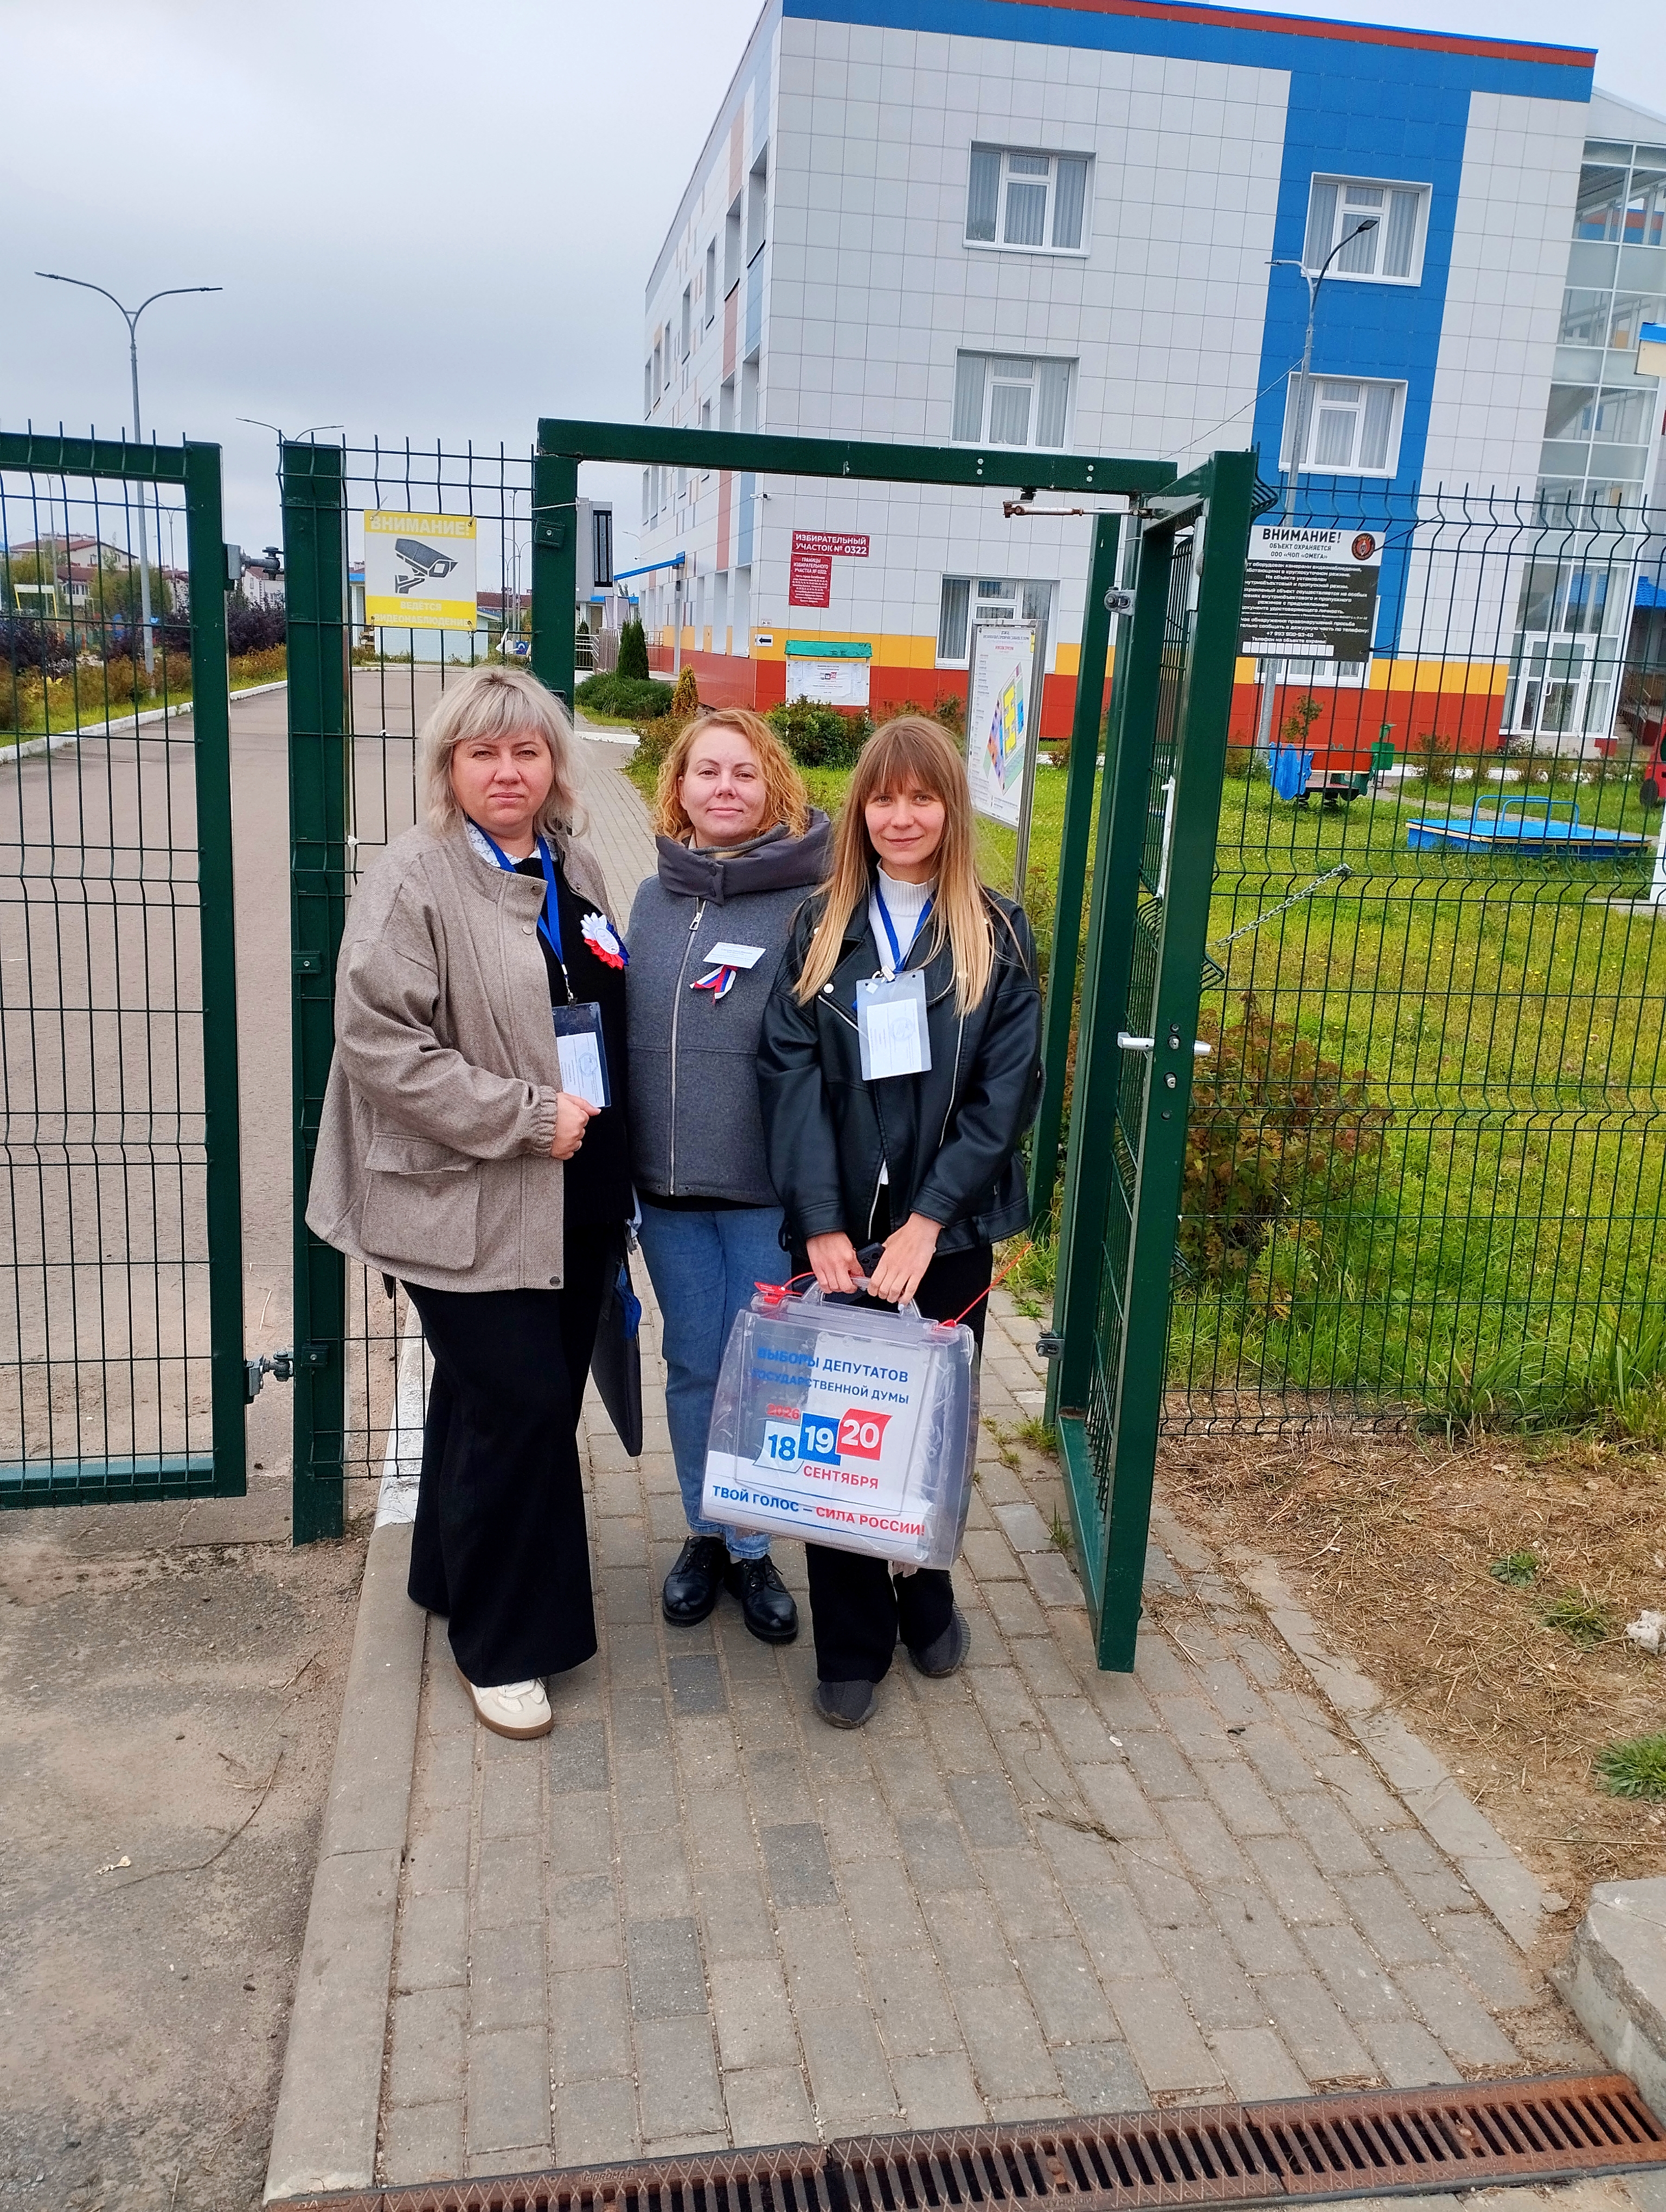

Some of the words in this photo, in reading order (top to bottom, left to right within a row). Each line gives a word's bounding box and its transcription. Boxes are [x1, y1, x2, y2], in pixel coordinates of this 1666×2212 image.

[370, 516, 470, 536] ВНИМАНИЕ!
[796, 534, 867, 545] ИЗБИРАТЕЛЬНЫЙ
[1263, 528, 1342, 543] ВНИМАНИЕ!
[796, 543, 832, 552] УЧАСТОК
[844, 546, 867, 554] 0322
[374, 614, 468, 627] ВИДЕОНАБЛЮДЕНИЕ
[757, 1346, 819, 1368] ВЫБОРЫ
[822, 1358, 909, 1383] ДЕПУТАТОВ
[751, 1368, 868, 1397] ГОСУДАРСТВЕННОЙ
[871, 1389, 909, 1405] ДУМЫ
[766, 1403, 800, 1420] 2026
[768, 1434, 796, 1461] 18
[805, 1425, 834, 1454] 19
[841, 1419, 880, 1449] 20
[803, 1465, 879, 1489] СЕНТЯБРЯ
[713, 1485, 748, 1503] ТВОЙ
[753, 1494, 799, 1512] ГОЛОС
[816, 1506, 855, 1524] СИЛА
[860, 1514, 925, 1536] РОССИИ!
[583, 2170, 634, 2182] GIDROMAT
